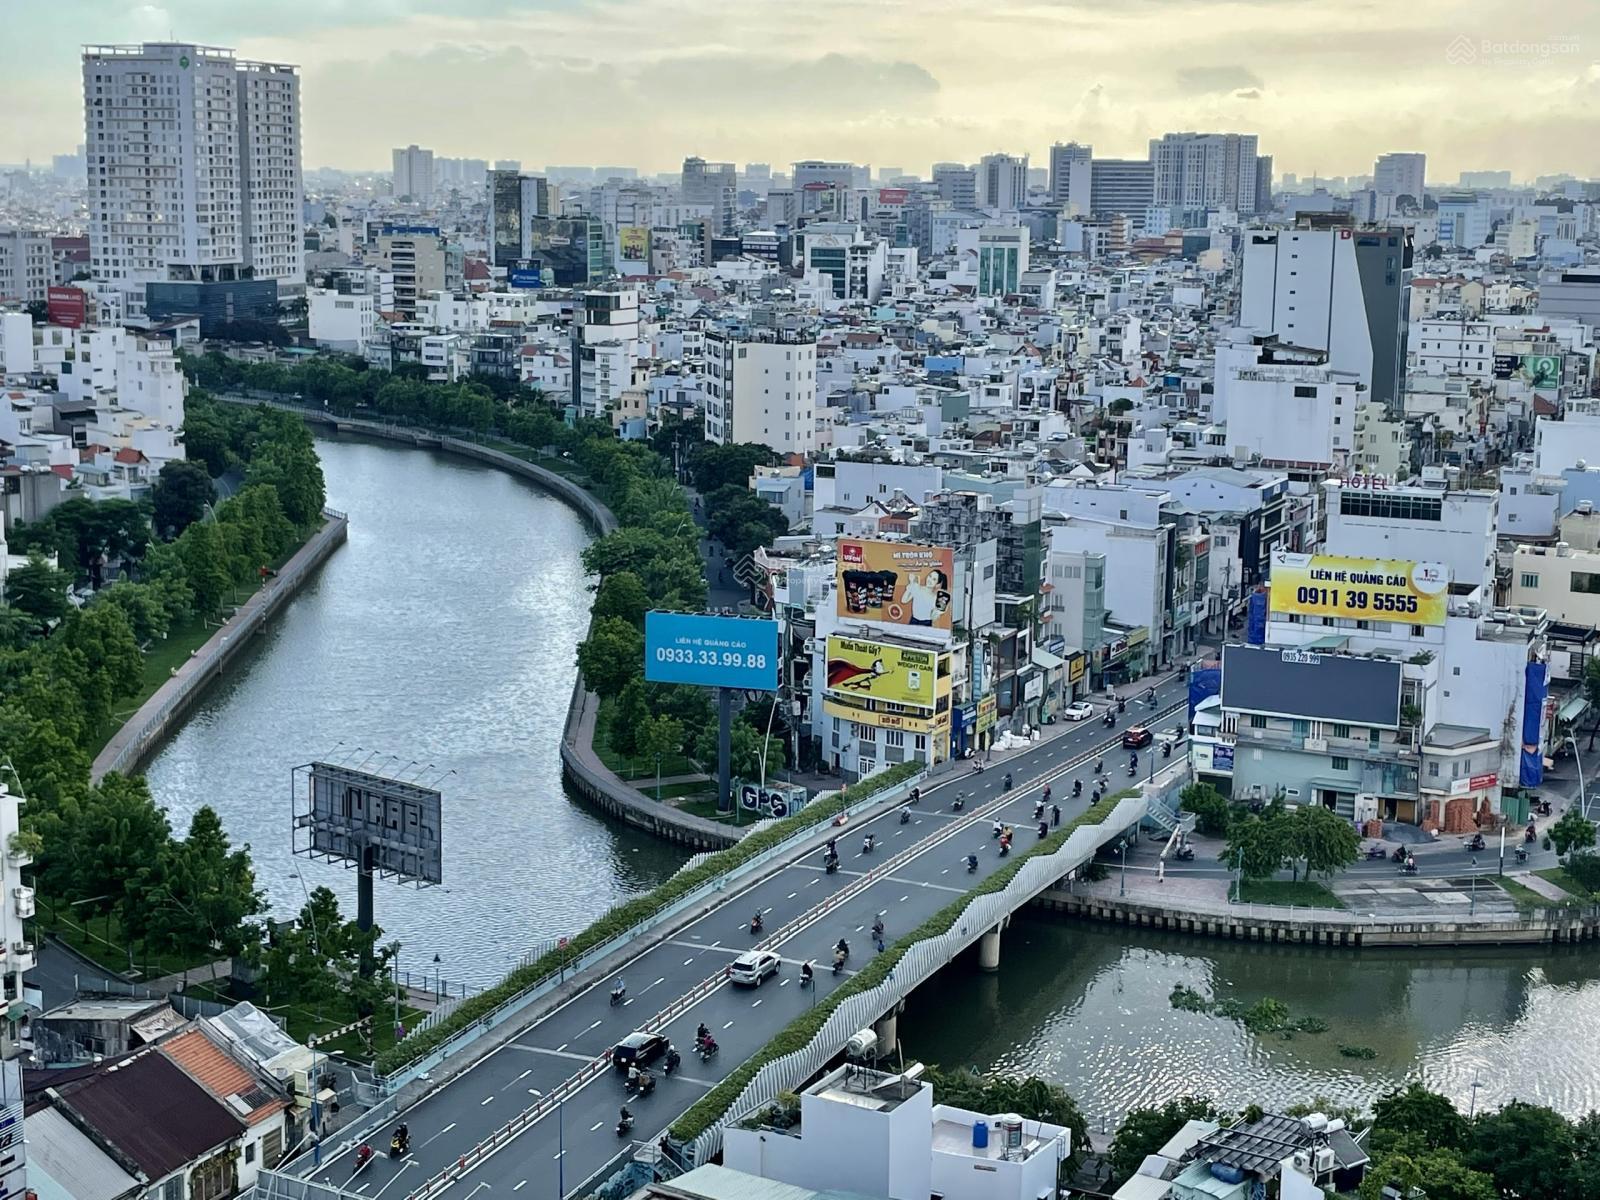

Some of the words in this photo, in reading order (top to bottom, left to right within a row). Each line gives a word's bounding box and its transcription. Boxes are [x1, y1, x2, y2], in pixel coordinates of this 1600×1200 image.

[1338, 477, 1389, 491] HOTEL
[1310, 568, 1332, 581] LIÊN
[1334, 569, 1347, 585] HỆ
[1350, 570, 1384, 585] QUẢNG
[1386, 574, 1407, 587] CÁO
[1297, 586, 1339, 607] 0911
[1346, 590, 1368, 609] 39
[1373, 592, 1418, 613] 5555
[675, 636, 691, 645] LIÊN
[692, 637, 702, 646] HỆ
[704, 637, 730, 648] QUẢNG
[731, 639, 747, 649] CÁO
[656, 647, 766, 669] 0933.33.99.88
